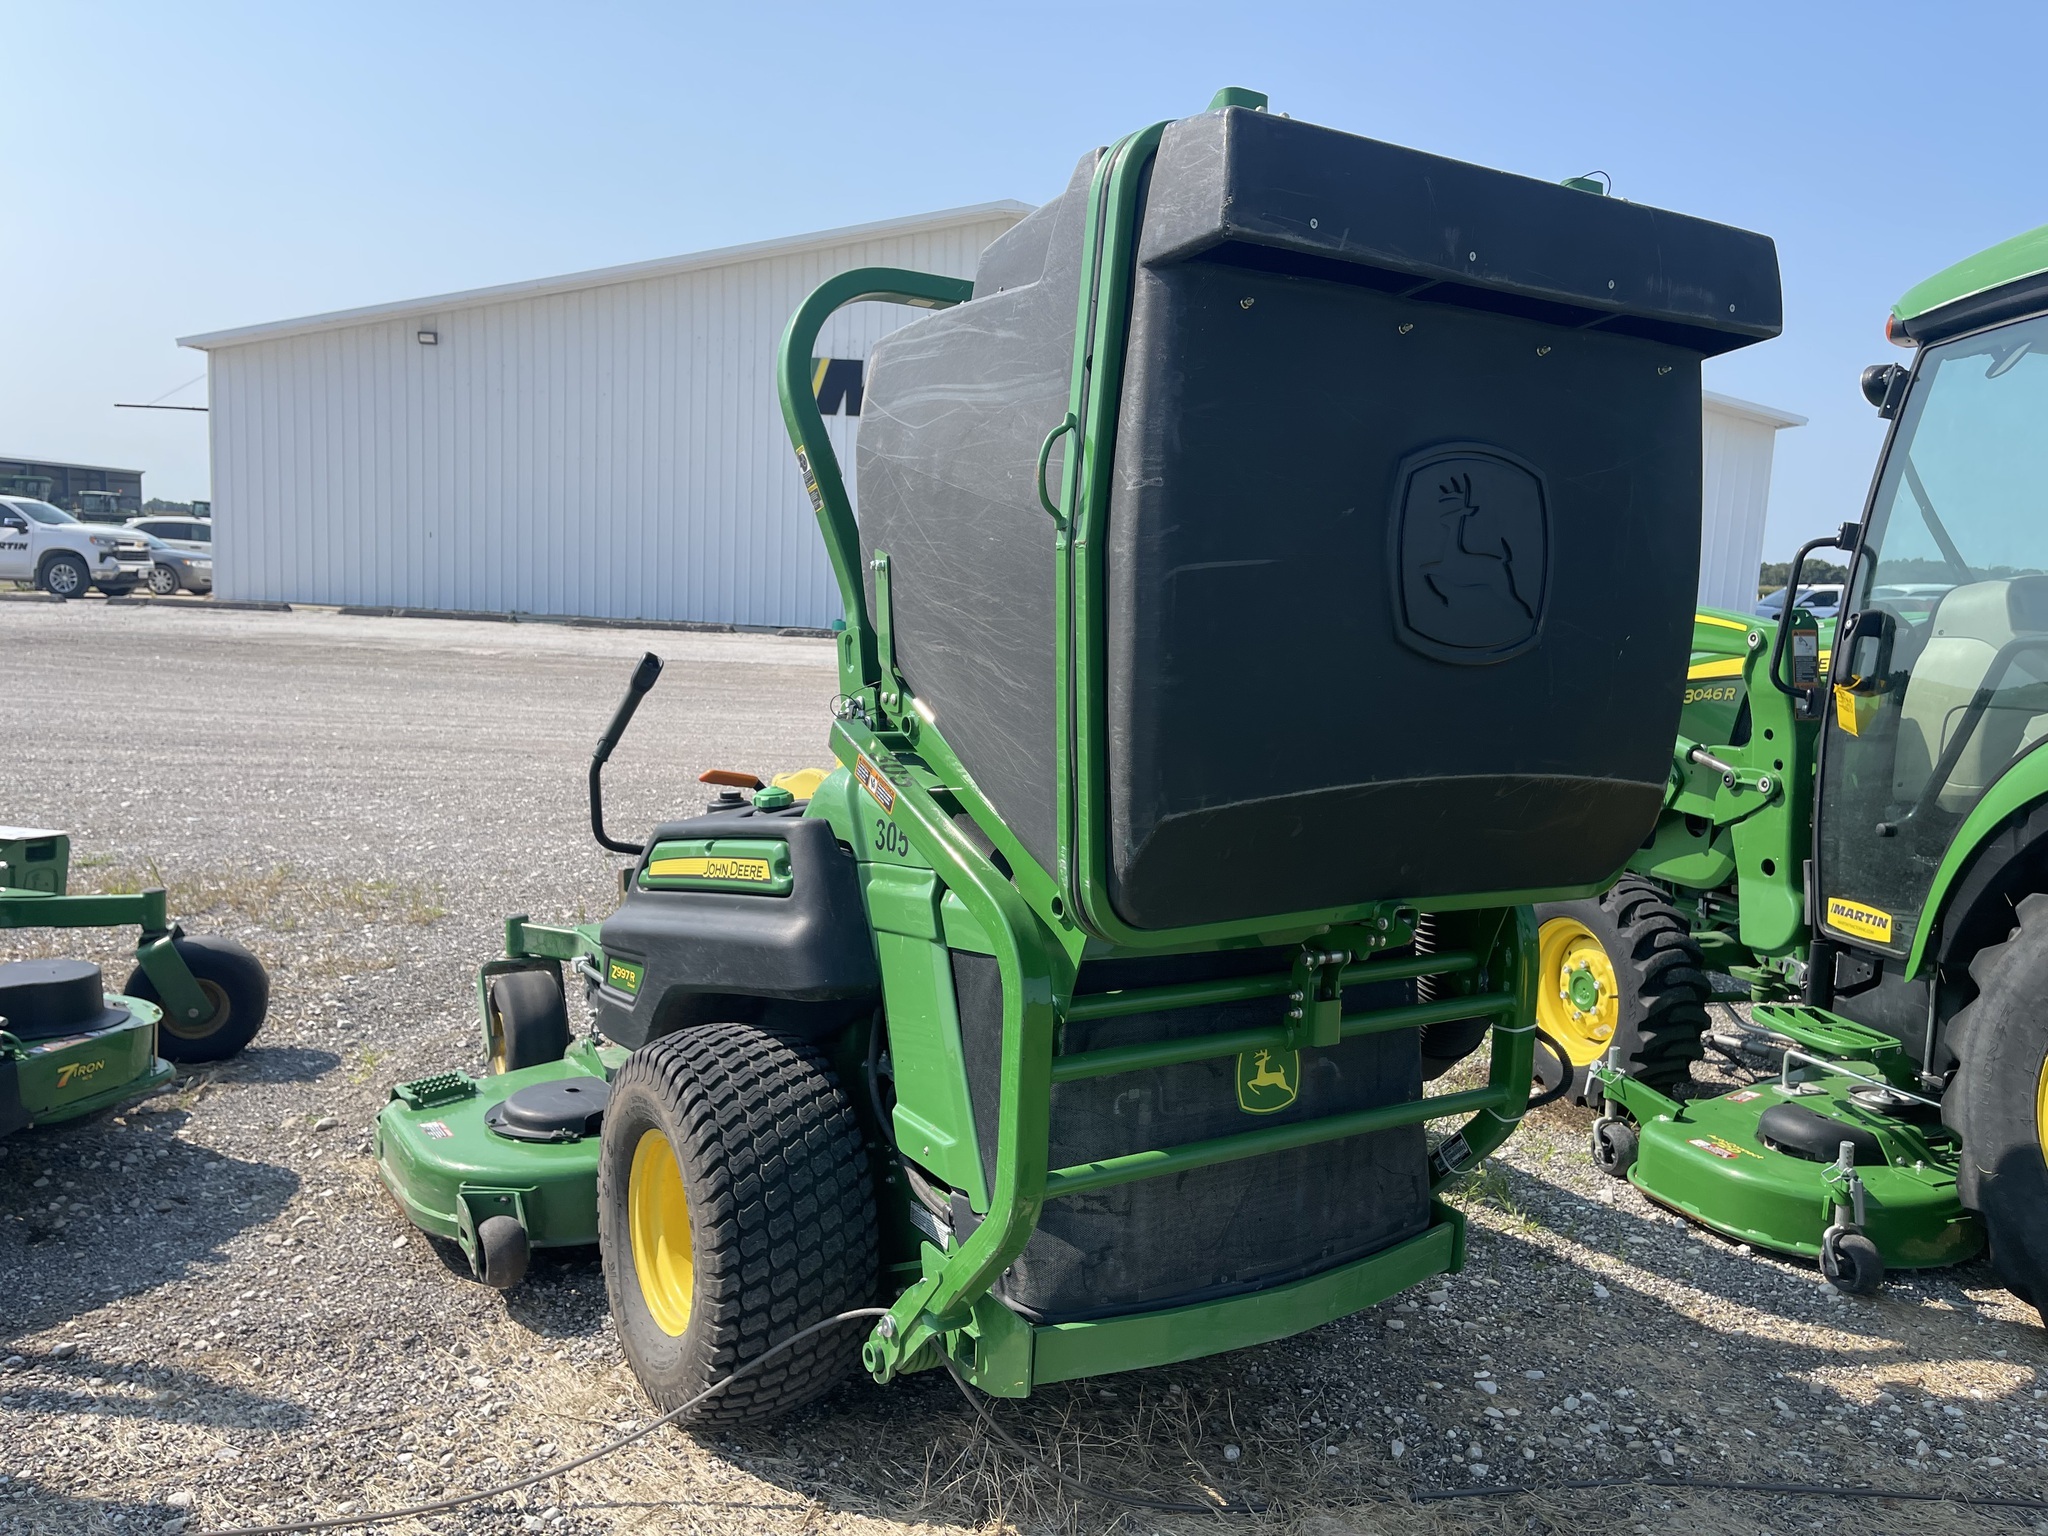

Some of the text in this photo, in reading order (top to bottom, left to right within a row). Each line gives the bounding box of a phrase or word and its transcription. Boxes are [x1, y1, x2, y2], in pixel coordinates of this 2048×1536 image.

[875, 818, 909, 857] 305
[703, 860, 764, 879] JOHN DEERE
[1832, 903, 1889, 930] MARTIN
[611, 964, 636, 983] Z997R
